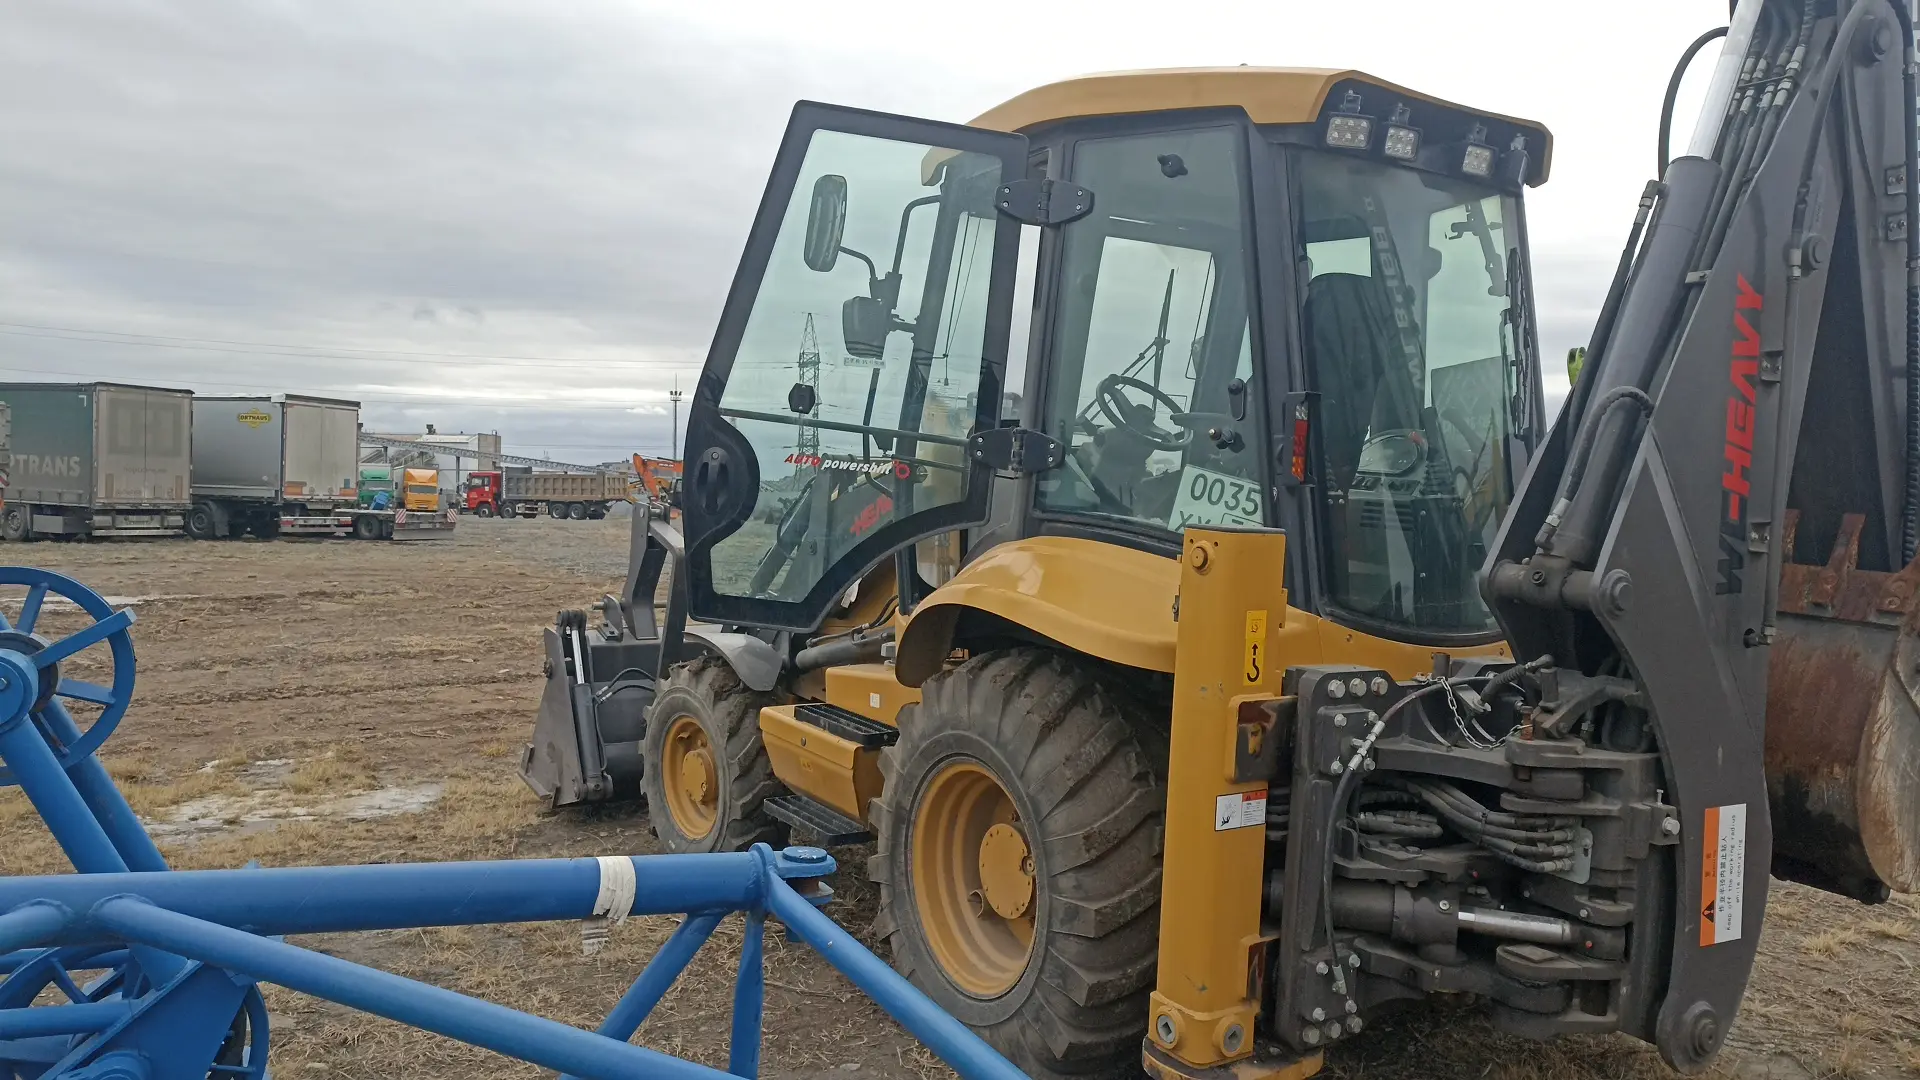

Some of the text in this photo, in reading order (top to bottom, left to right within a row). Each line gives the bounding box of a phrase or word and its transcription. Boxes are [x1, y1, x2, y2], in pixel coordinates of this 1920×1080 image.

[784, 453, 894, 475] AUTO powershift
[1190, 473, 1261, 516] 0035
